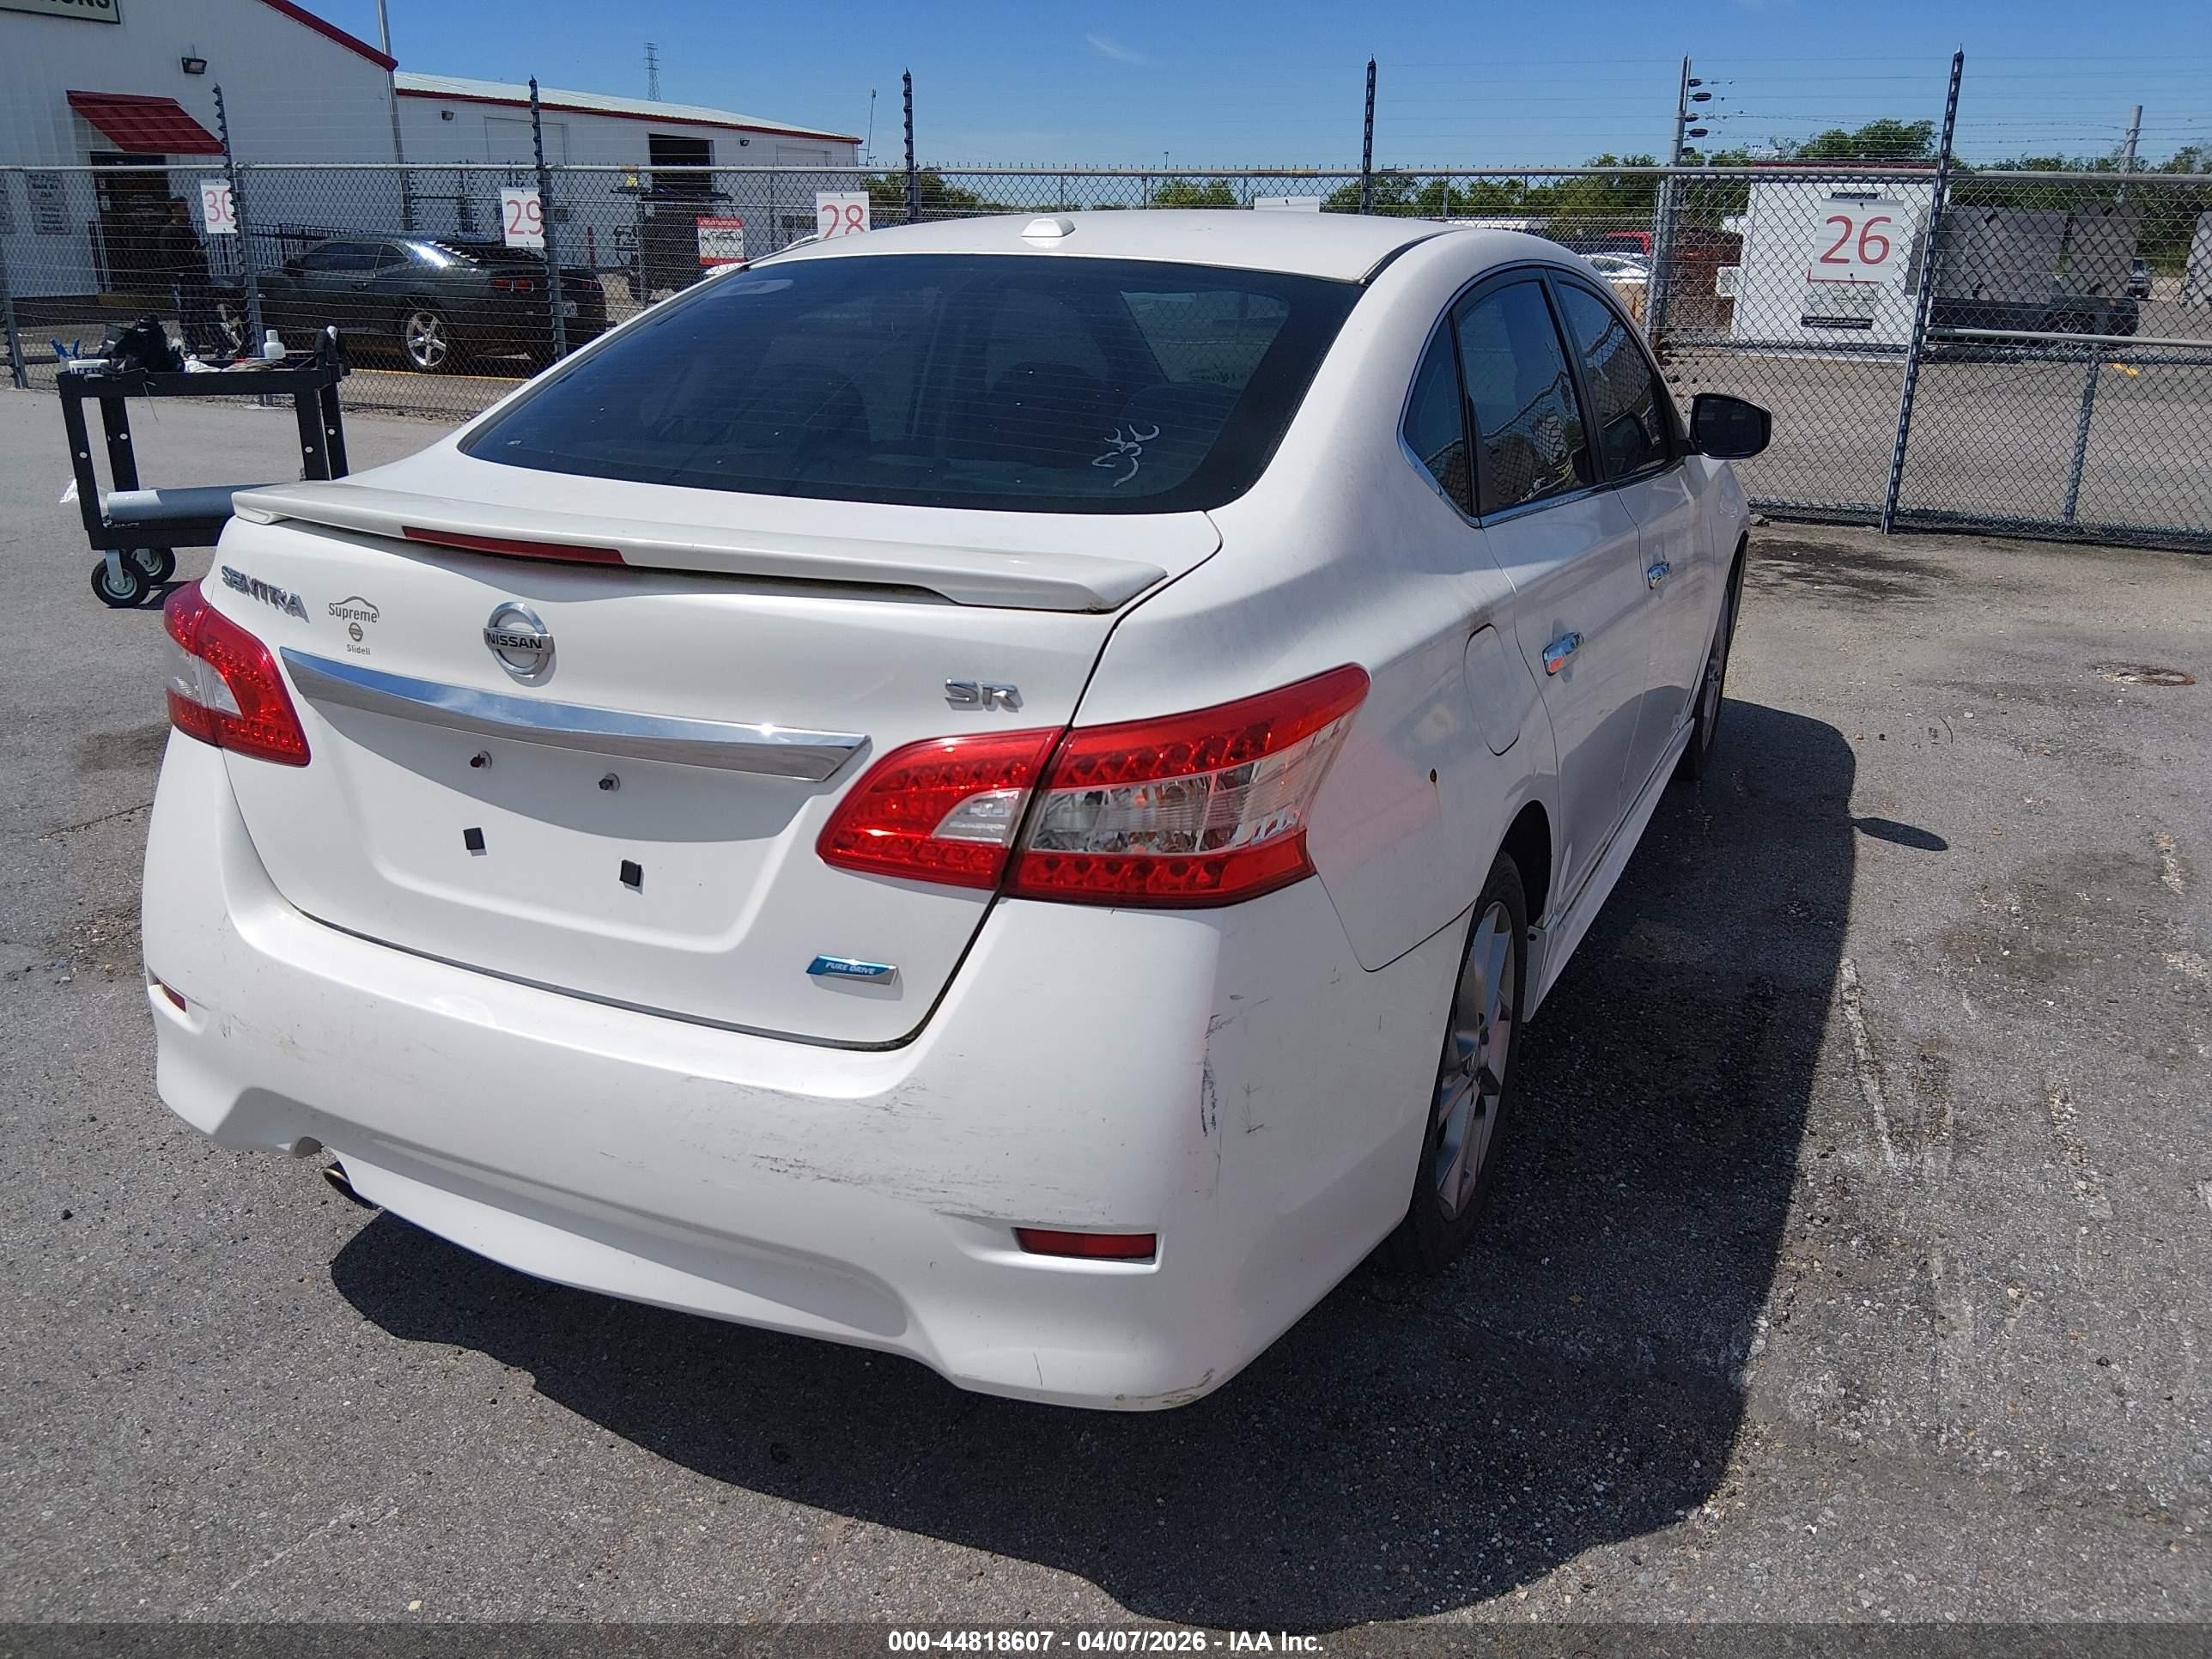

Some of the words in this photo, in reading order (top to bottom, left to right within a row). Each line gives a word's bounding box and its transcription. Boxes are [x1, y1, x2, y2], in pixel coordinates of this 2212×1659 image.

[205, 190, 234, 222] 30
[507, 199, 544, 235] 29
[822, 204, 866, 239] 28
[1820, 215, 1892, 265] 26
[221, 565, 311, 623] SENTRA
[329, 603, 378, 623] Supreme
[346, 644, 371, 656] Slidell
[487, 632, 543, 649] NISSAN
[945, 679, 1018, 708] SR
[825, 962, 848, 971] PURE
[849, 964, 877, 975] DRIVE
